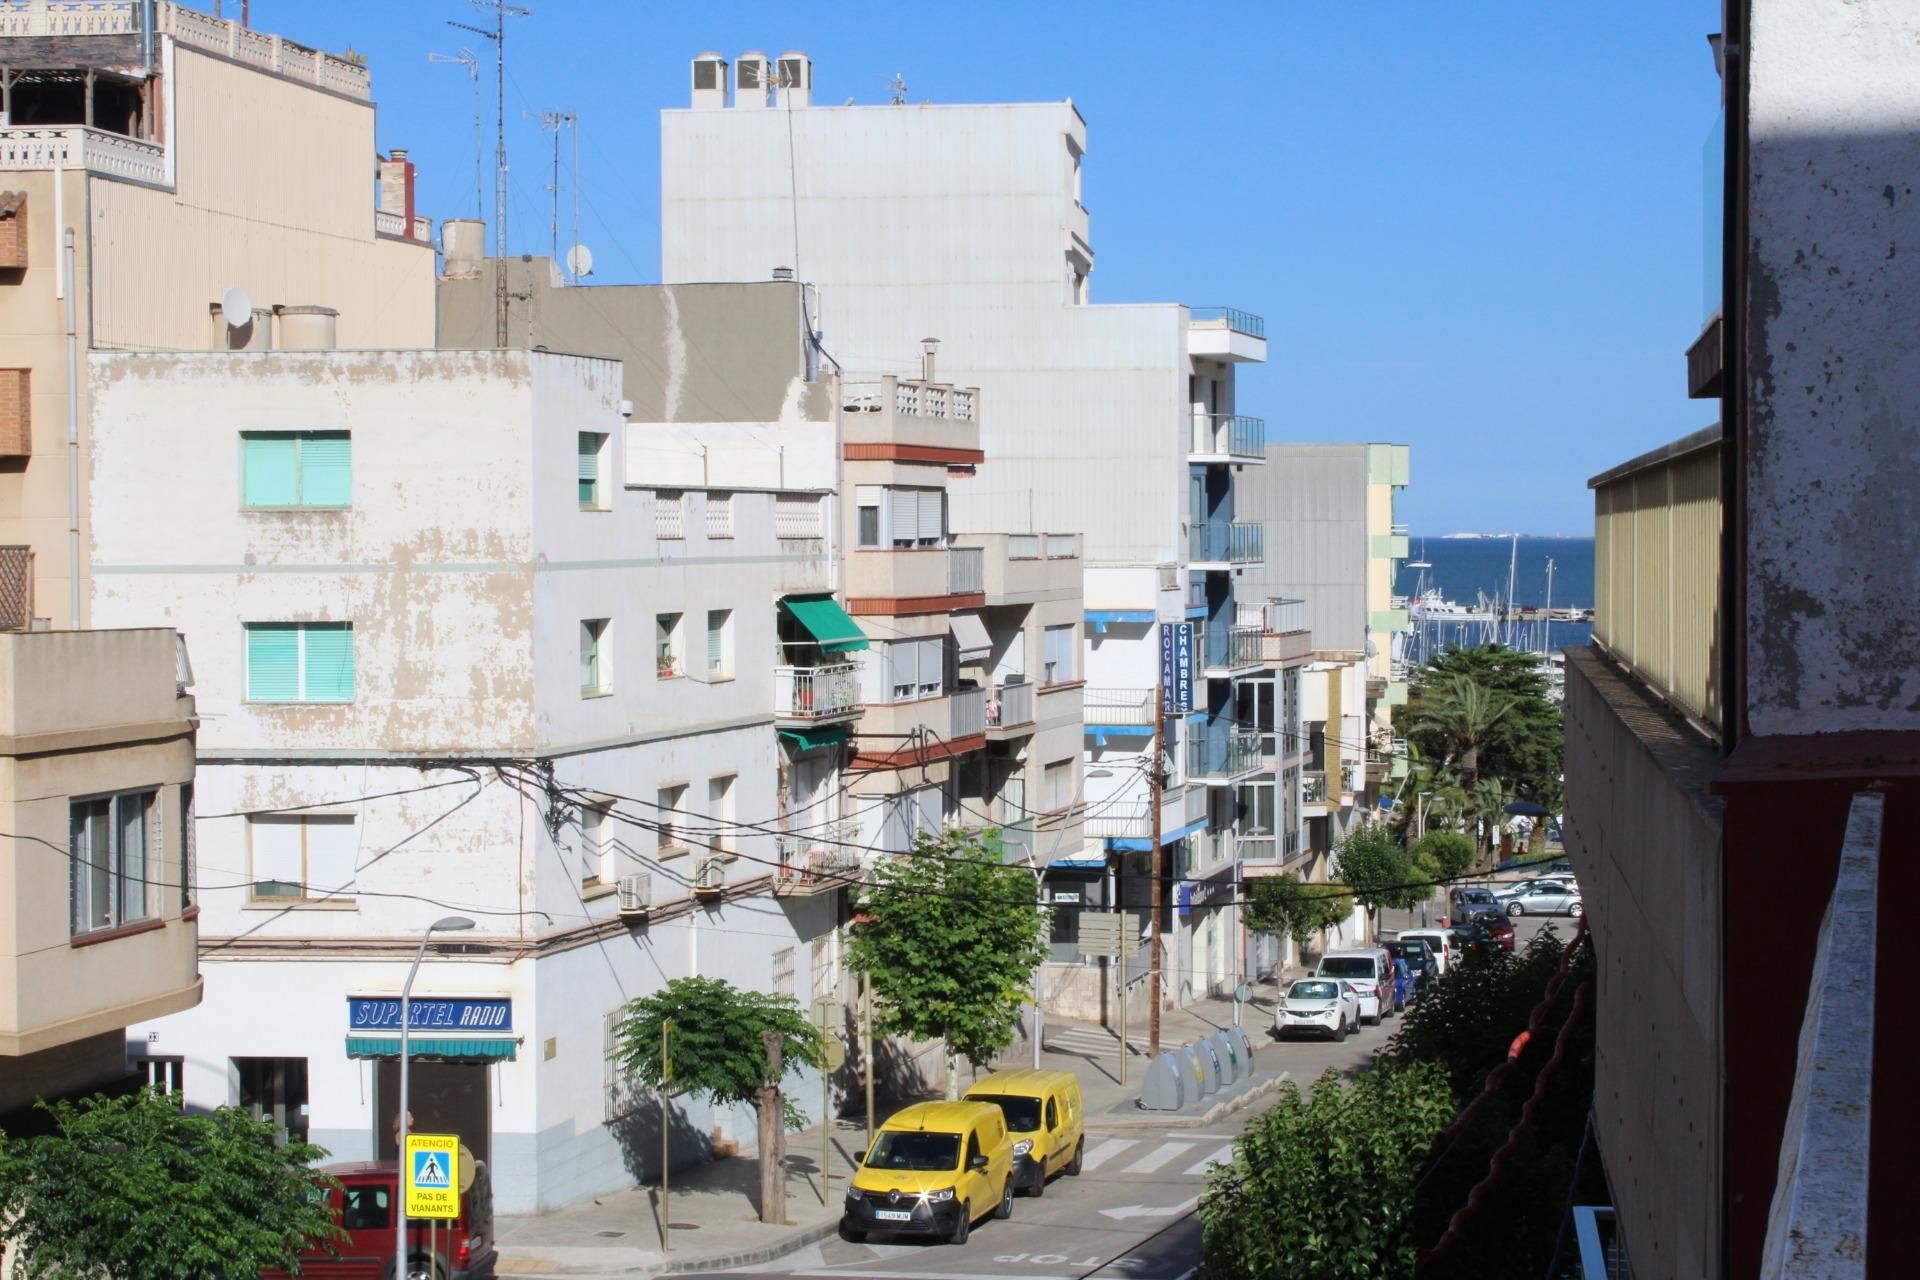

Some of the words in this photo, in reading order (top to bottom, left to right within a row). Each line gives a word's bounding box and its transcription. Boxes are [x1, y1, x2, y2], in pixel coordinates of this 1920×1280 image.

[1163, 625, 1171, 712] ROCAMAR
[1179, 625, 1189, 712] CHAMBRES
[459, 1005, 506, 1026] RADIO
[416, 1193, 433, 1201] PAS
[435, 1193, 448, 1201] DE
[411, 1204, 454, 1213] VIANANTS
[992, 1253, 1145, 1268] STOP
